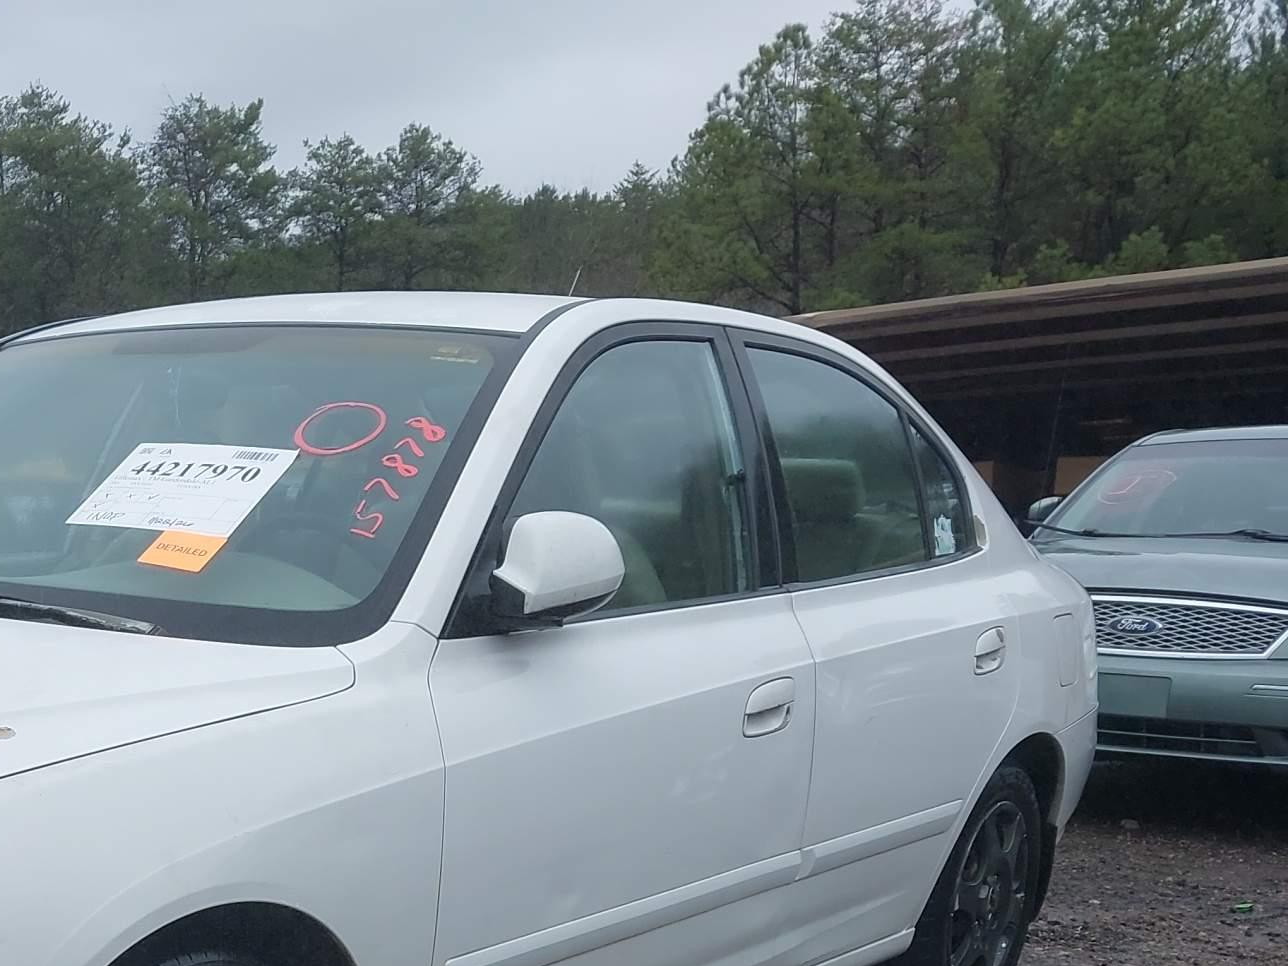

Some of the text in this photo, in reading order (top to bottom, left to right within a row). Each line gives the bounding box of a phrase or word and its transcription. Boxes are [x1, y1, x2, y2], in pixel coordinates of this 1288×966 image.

[131, 460, 262, 484] 44217970
[349, 416, 446, 538] 157878
[156, 542, 208, 558] DETAILED
[1117, 618, 1149, 631] Ford
